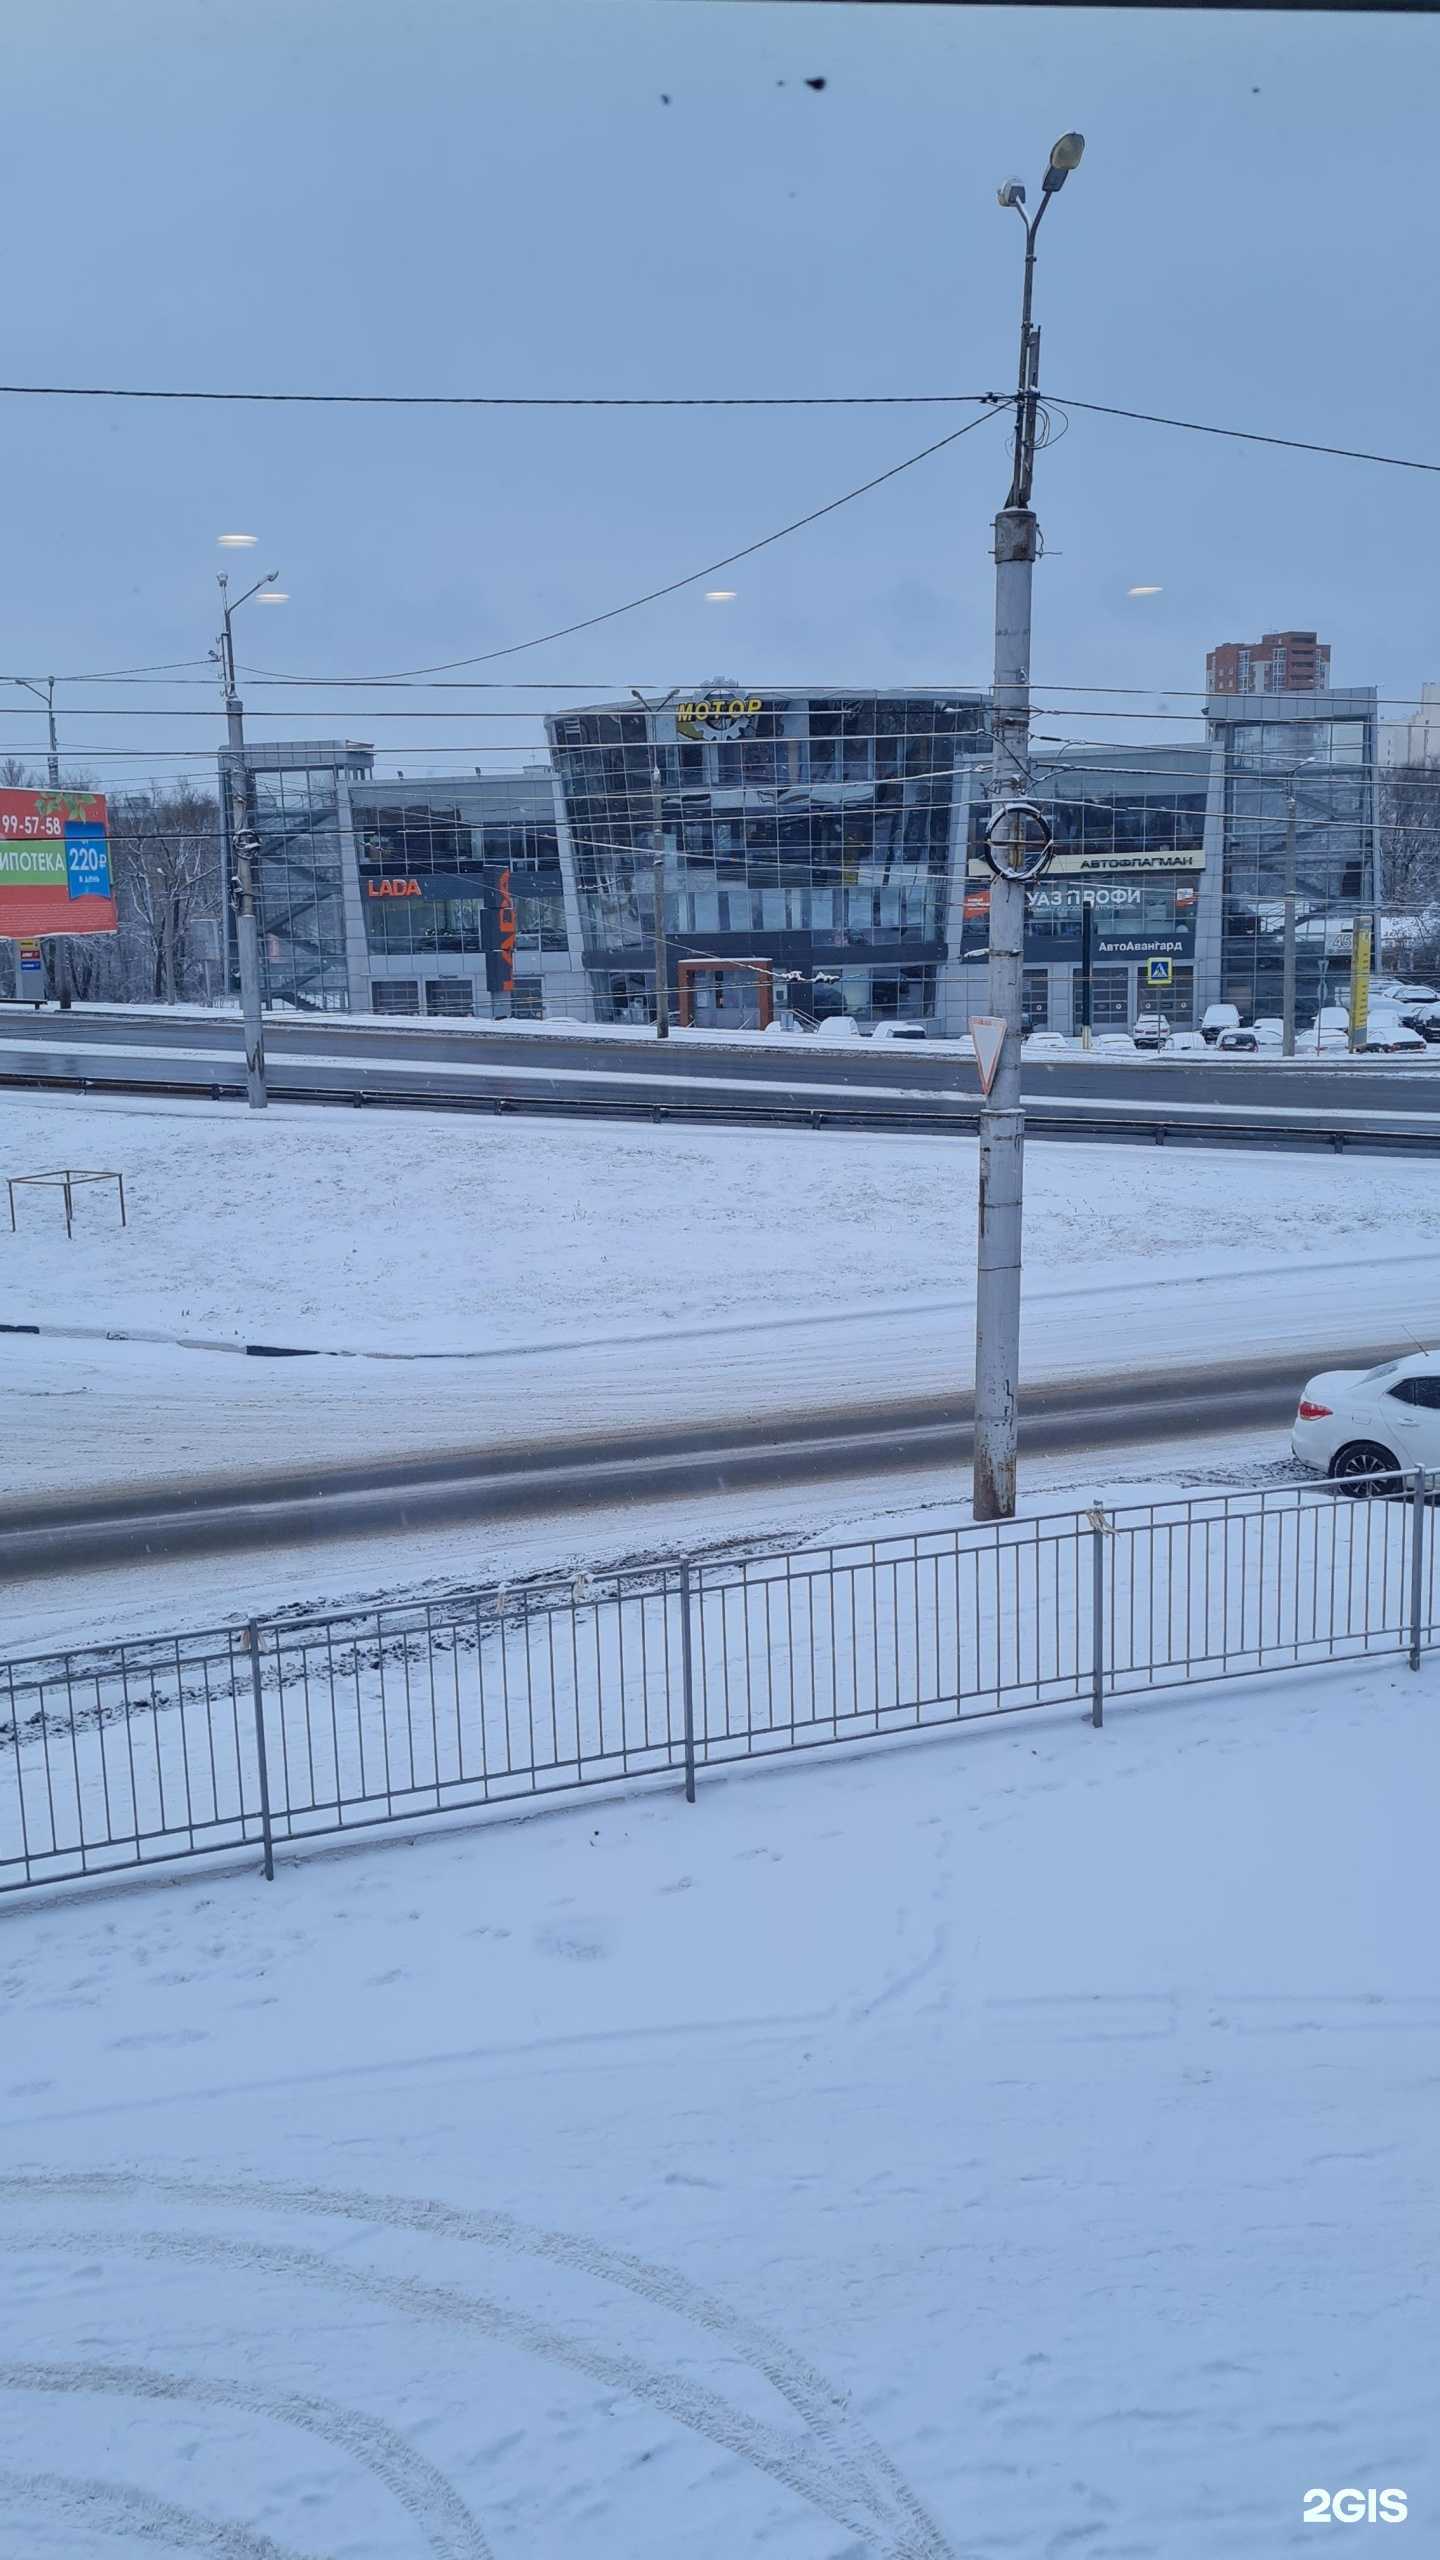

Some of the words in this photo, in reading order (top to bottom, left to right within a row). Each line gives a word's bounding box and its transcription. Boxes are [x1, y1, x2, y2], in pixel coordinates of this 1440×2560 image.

[677, 698, 762, 722] МОТОР
[2, 815, 61, 835] 99-57-58
[0, 852, 66, 872] ИПОТЕКА
[1080, 857, 1193, 869] АВТОФЛАГМАН
[368, 879, 422, 897] LADA
[1025, 890, 1062, 906] УАЗ
[1067, 888, 1141, 908] ПРОФИ
[498, 868, 516, 992] LADA
[1098, 941, 1183, 953] АвтоАвангард
